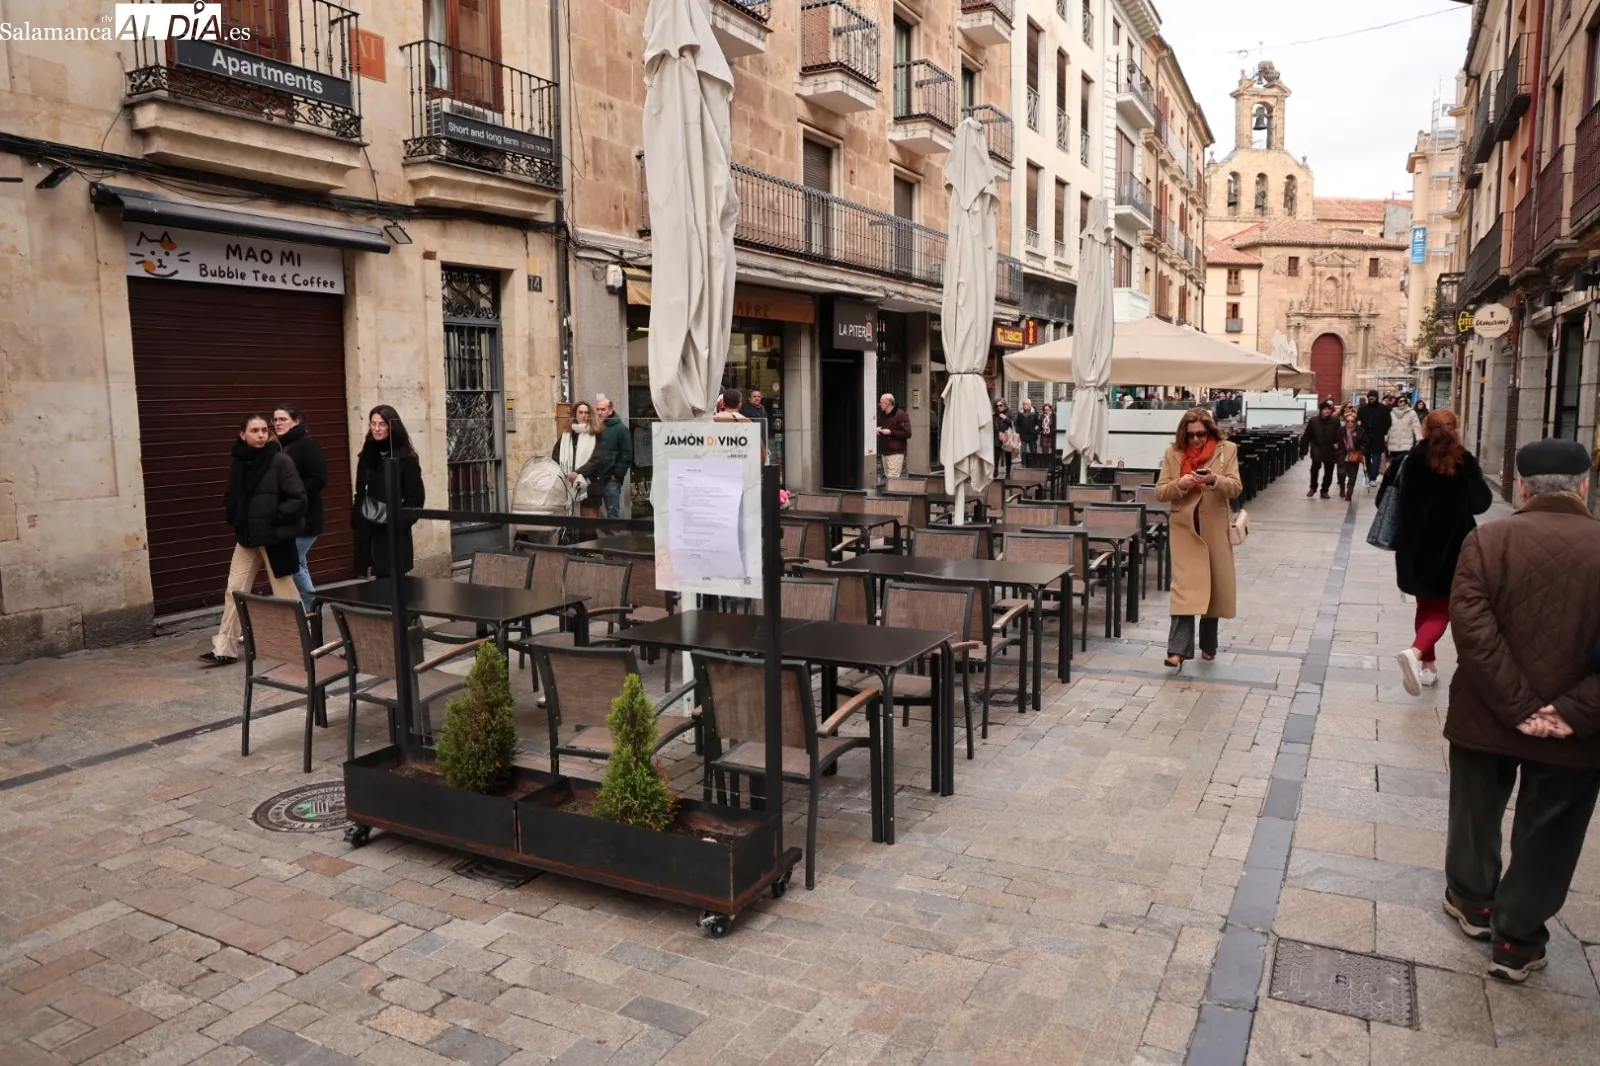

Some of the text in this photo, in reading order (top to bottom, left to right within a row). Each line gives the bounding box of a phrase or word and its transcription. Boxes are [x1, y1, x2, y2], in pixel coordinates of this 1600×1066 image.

[211, 48, 323, 95] Apartments
[448, 121, 519, 147] Short and long term
[225, 244, 302, 267] MAO MI
[198, 263, 336, 289] Bubble Tea & Coffee
[529, 276, 540, 290] 14
[838, 323, 848, 336] LA
[664, 433, 704, 446] JAMÓN
[718, 436, 748, 446] VINO
